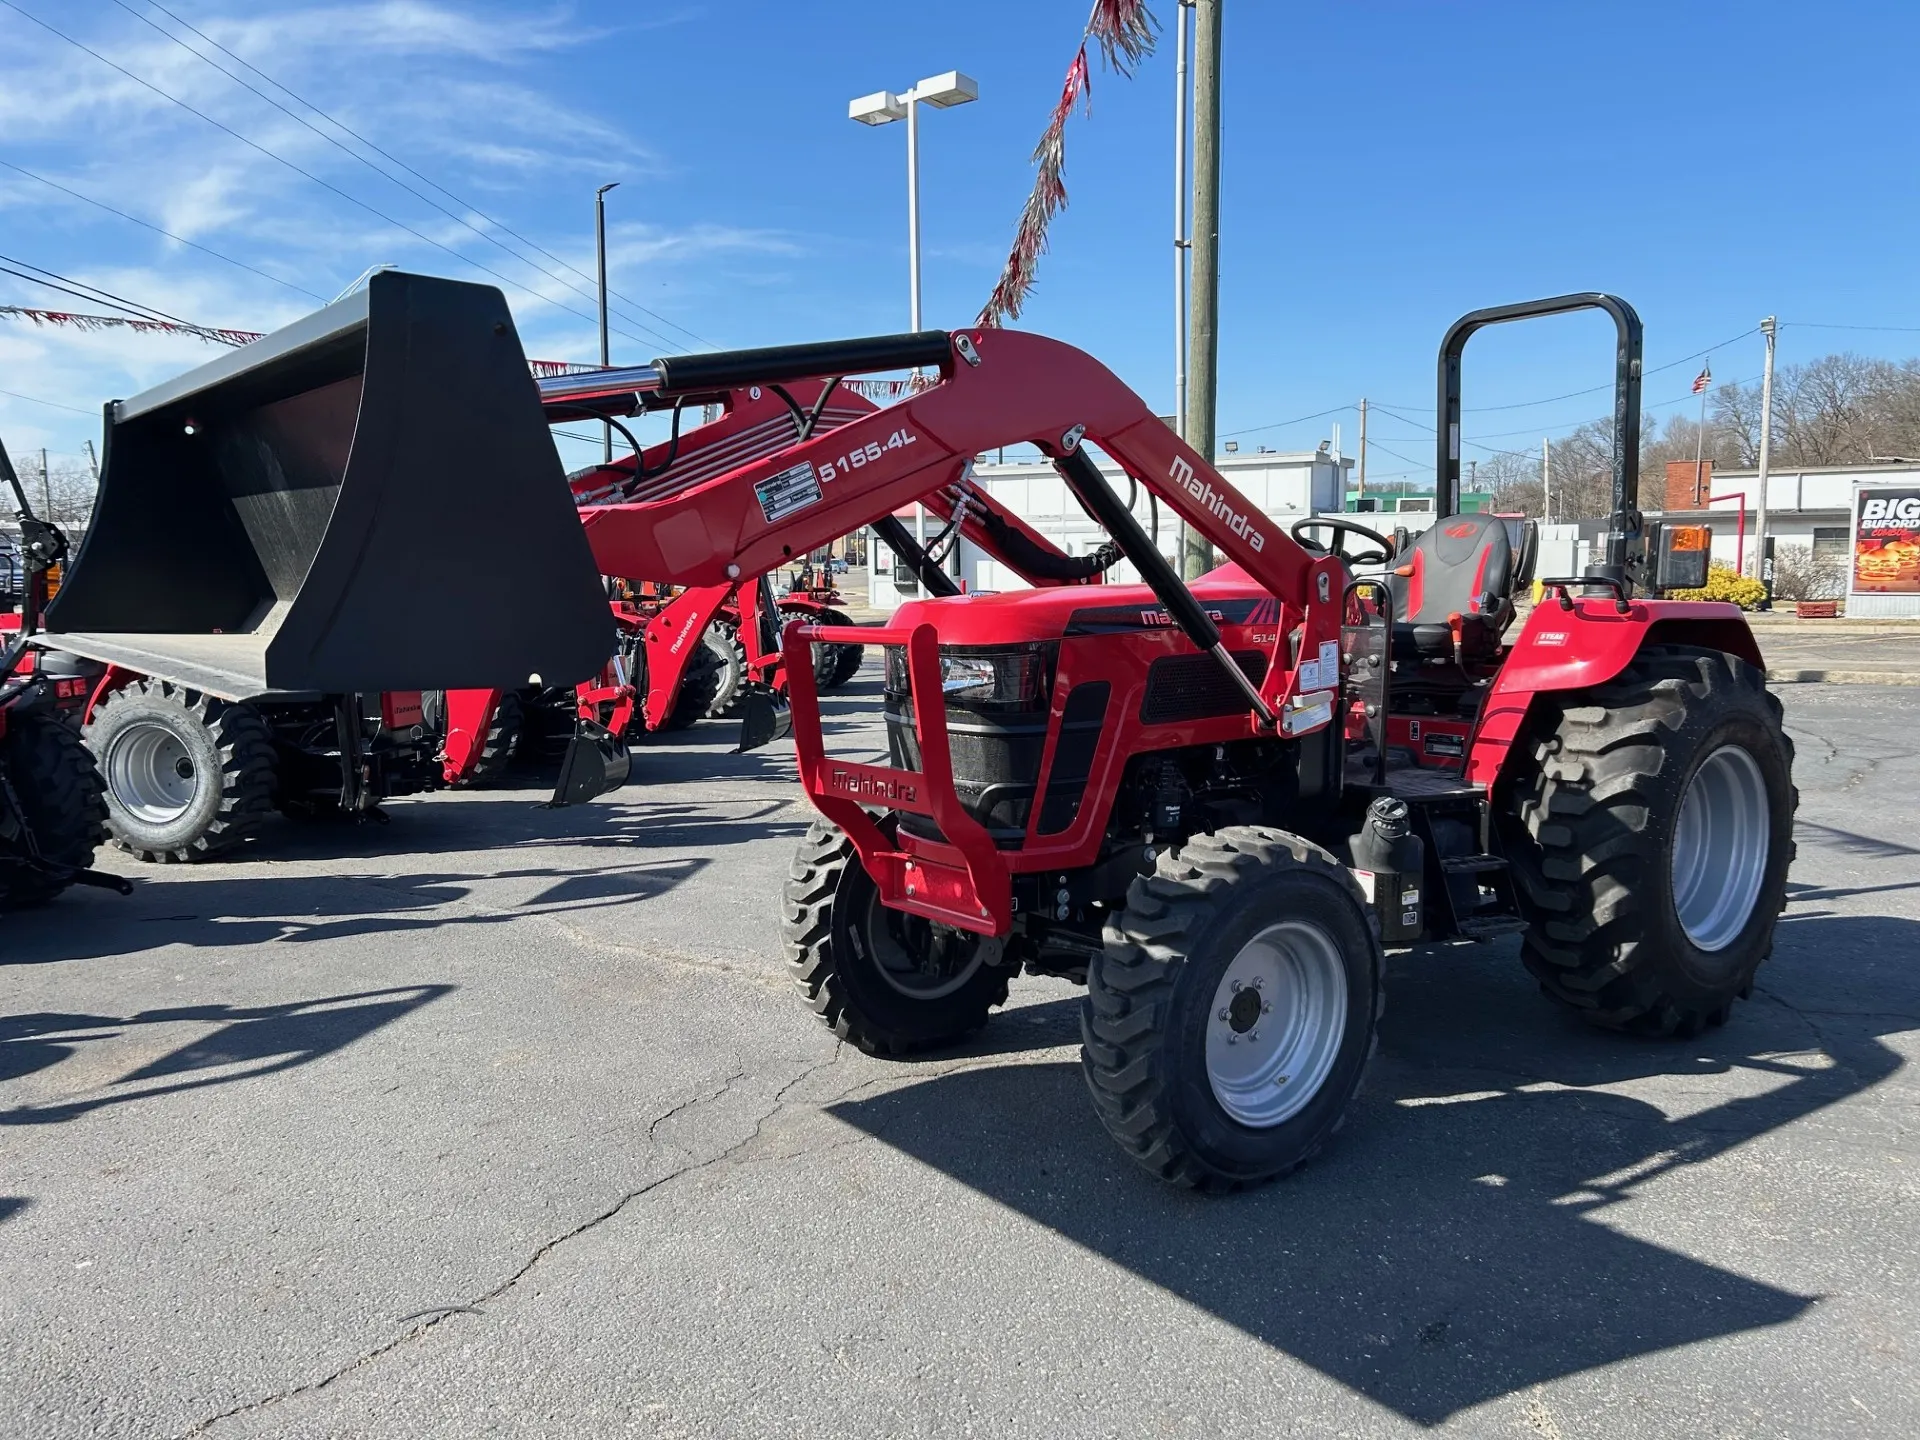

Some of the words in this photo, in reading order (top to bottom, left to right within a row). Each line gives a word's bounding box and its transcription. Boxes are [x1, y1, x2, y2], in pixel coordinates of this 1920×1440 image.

[1168, 455, 1265, 553] Mahindra
[1861, 498, 1920, 520] BIG
[1861, 519, 1920, 529] BUFORD
[670, 611, 698, 654] Mahindra
[832, 768, 917, 803] Mahindra
